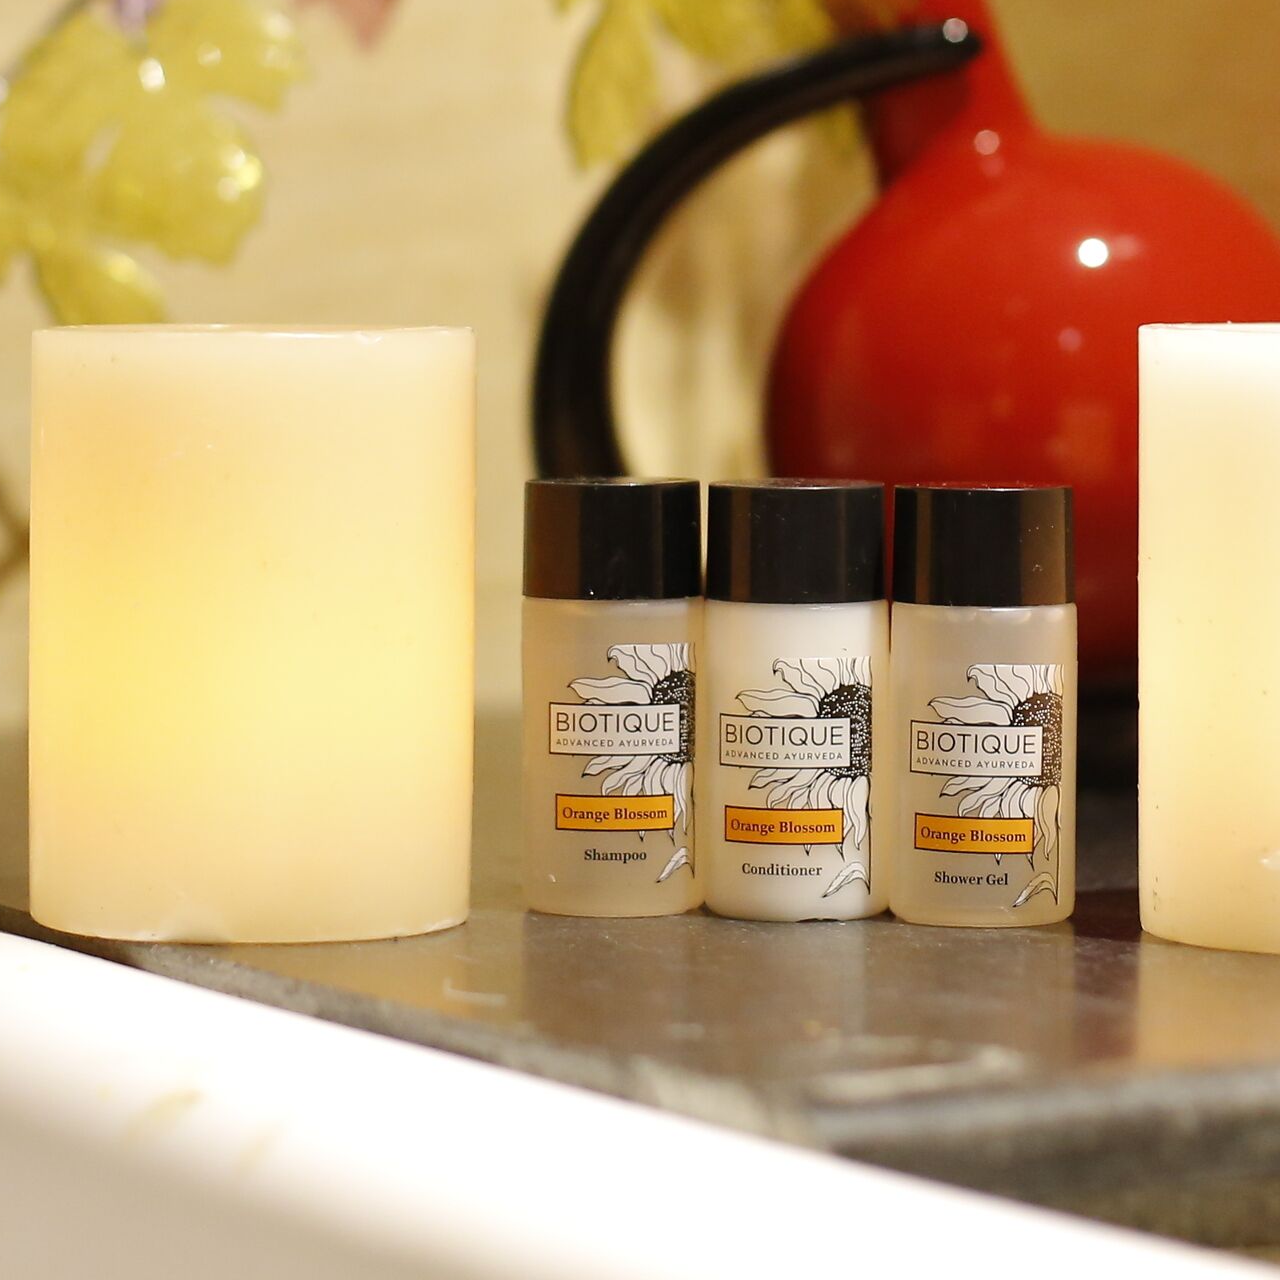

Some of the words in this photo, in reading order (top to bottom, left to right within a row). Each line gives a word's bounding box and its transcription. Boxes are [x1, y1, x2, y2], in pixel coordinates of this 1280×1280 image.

[556, 712, 675, 733] BIOTIQUE
[725, 724, 844, 746] BIOTIQUE
[917, 731, 1035, 754] BIOTIQUE
[556, 739, 614, 747] ADVANCED
[619, 739, 674, 747] AYURVEDA
[725, 750, 779, 760] ADVANCED
[784, 752, 843, 760] AYURVEDA
[917, 757, 971, 768] ADVANCED
[977, 761, 1035, 769] AYURVEDA
[562, 807, 609, 823] Orange
[614, 808, 667, 820] Blossom
[731, 818, 775, 835] Orange
[779, 821, 835, 833] Blossom
[921, 826, 965, 843] Orange
[970, 830, 1026, 843] Blossom
[584, 849, 647, 863] Shampoo
[742, 862, 823, 876] Conditioner
[934, 871, 983, 884] Shower
[986, 873, 1008, 885] Gel
